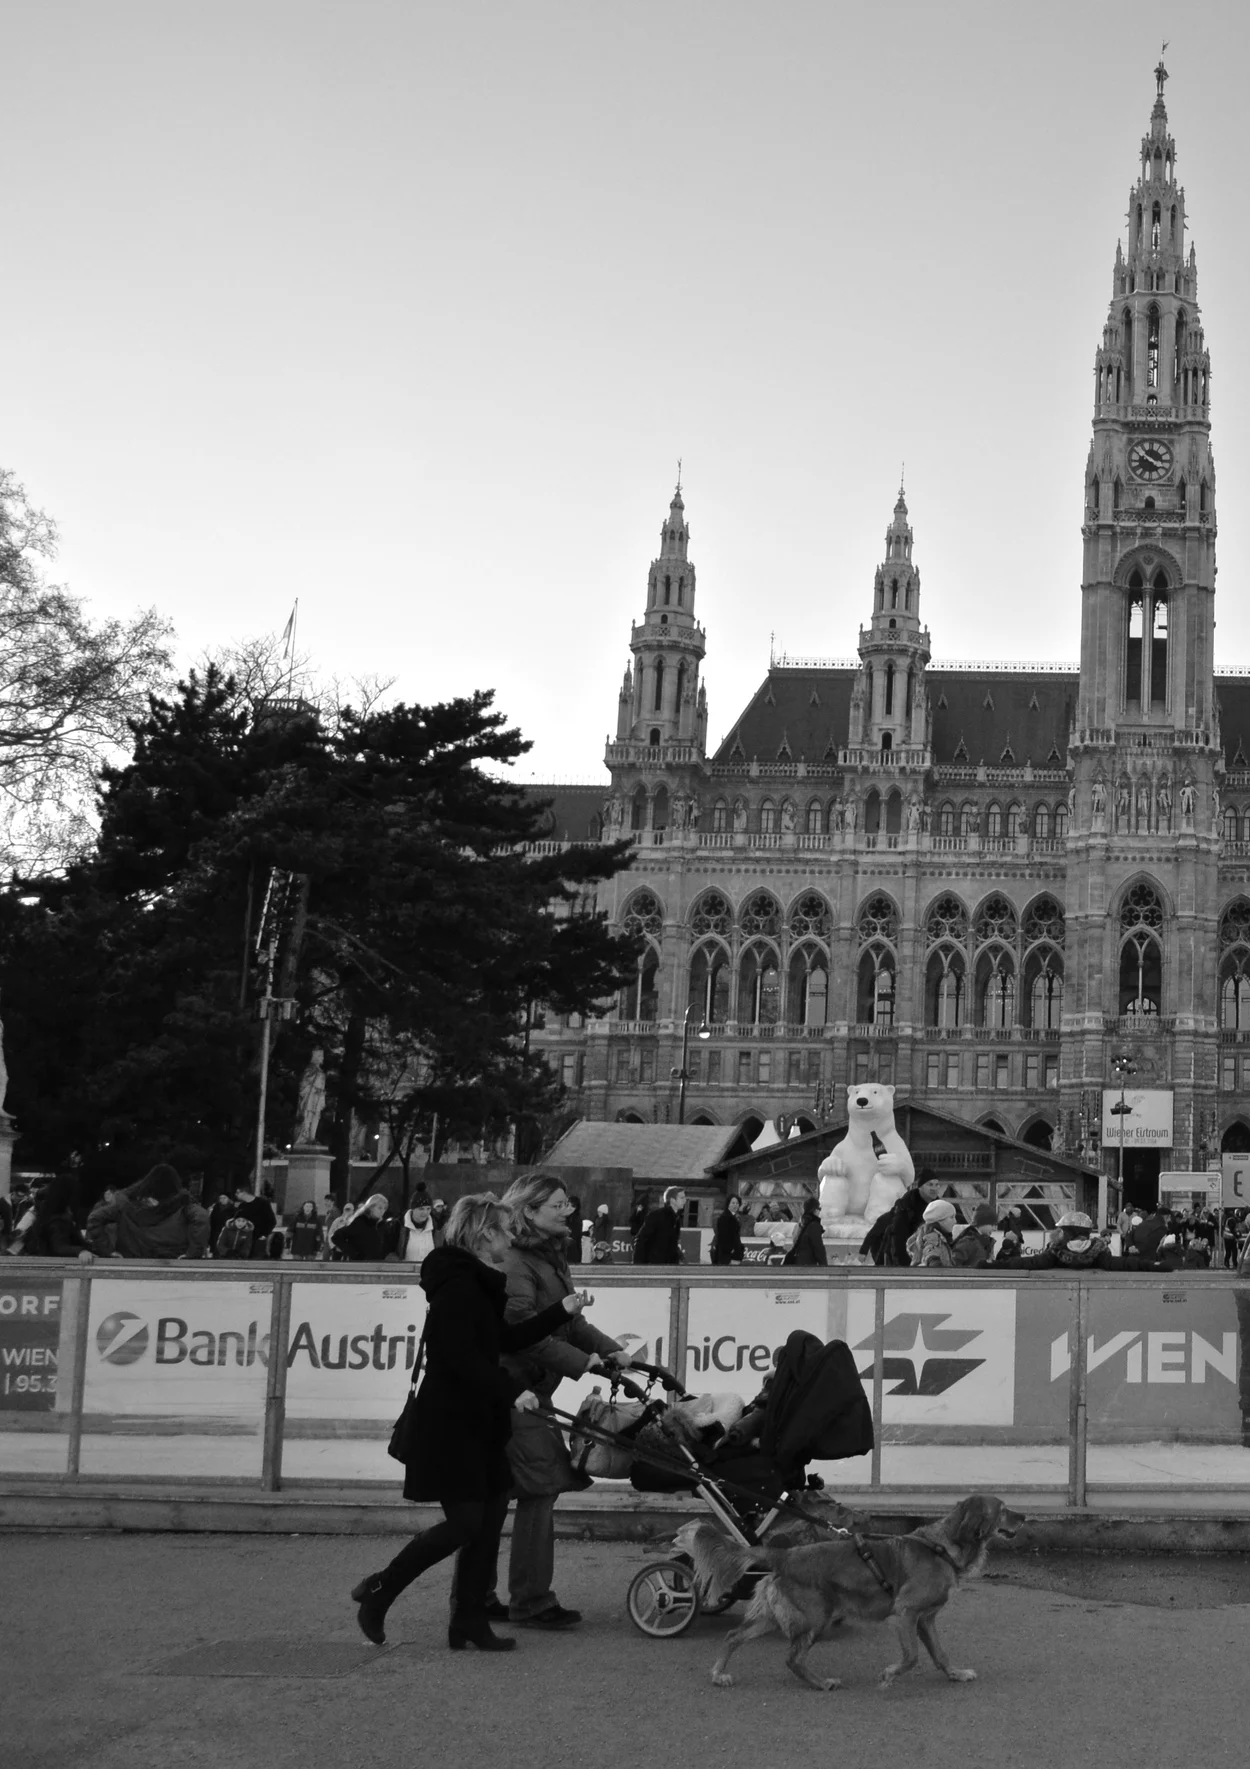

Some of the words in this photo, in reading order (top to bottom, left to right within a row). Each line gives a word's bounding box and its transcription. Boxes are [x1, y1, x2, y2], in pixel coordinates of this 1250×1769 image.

[0, 1295, 60, 1314] ORF
[2, 1348, 59, 1366] WIEN
[155, 1317, 271, 1367] Bank
[287, 1321, 426, 1371] Austri
[1050, 1331, 1237, 1384] WIEN
